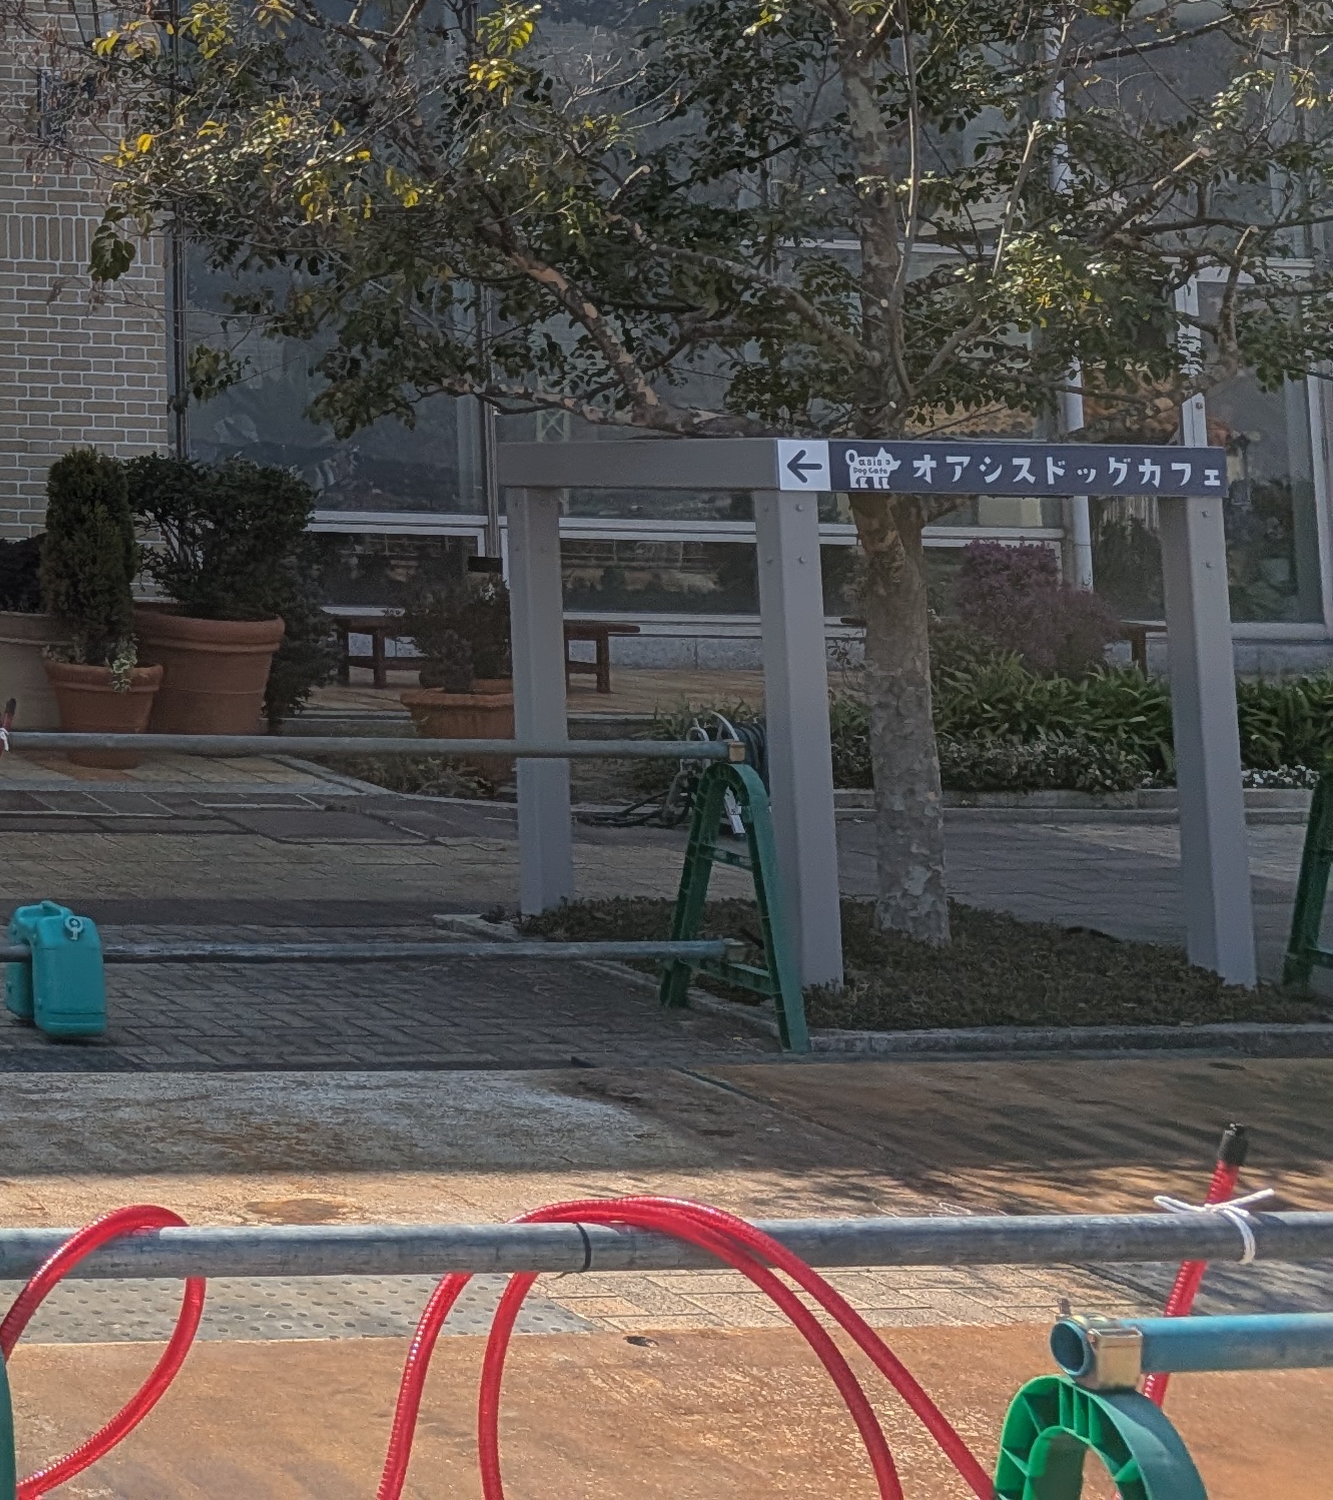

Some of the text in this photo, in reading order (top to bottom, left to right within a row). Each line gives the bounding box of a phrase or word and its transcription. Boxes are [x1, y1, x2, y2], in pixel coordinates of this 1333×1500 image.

[911, 453, 1221, 490] オアシスドッグカフェ
